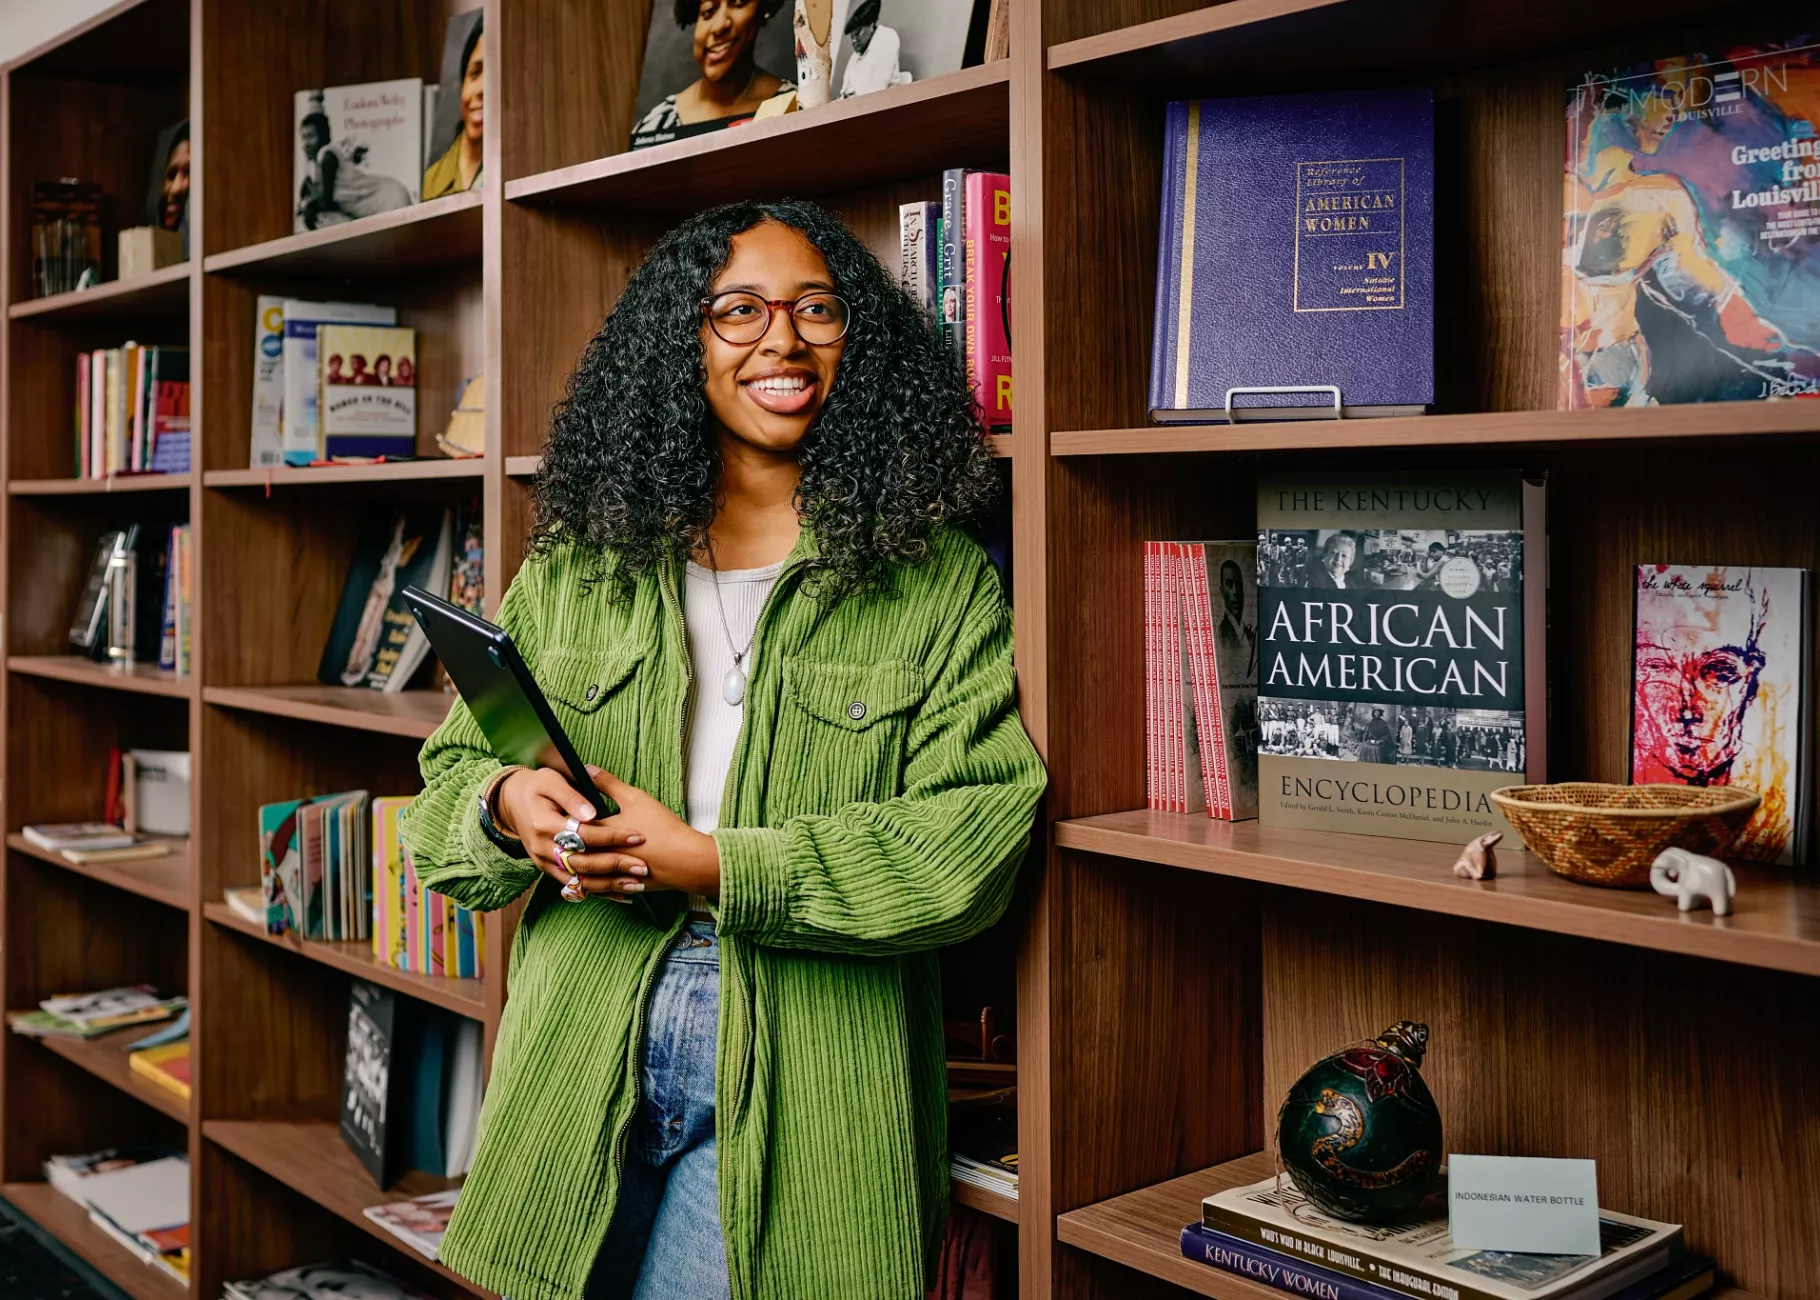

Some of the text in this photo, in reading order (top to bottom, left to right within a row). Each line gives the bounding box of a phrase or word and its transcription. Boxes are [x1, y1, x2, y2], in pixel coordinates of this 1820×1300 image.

[1672, 104, 1742, 123] LOUISVILLE
[1306, 166, 1362, 176] Reference
[1306, 176, 1365, 187] Library of
[944, 178, 956, 230] Grace
[1305, 194, 1394, 212] AMERICAN
[1304, 216, 1370, 232] WOMEN
[990, 233, 1002, 242] How
[944, 243, 956, 278] Grit
[1366, 252, 1396, 270] IV
[1340, 286, 1395, 294] International
[966, 286, 974, 320] YOUR
[966, 325, 974, 354] OWN
[1275, 489, 1493, 512] THE KENTUCKY
[1642, 574, 1659, 589] the
[1697, 578, 1742, 594] squirrel
[1265, 600, 1507, 650] AFRICAN
[1266, 651, 1509, 698] AMERICAN
[1280, 776, 1493, 814] ENCYCLOPEDIA
[1280, 801, 1299, 810] Edited
[1308, 804, 1328, 812] Gerald
[1336, 806, 1356, 815] Smith,
[1400, 812, 1431, 821] McDaniel,
[1470, 819, 1493, 827] Hardin
[1455, 1192, 1584, 1206] INDONESIAN WATER BOTTLE
[1205, 1244, 1339, 1300] KENTUCKY WOMEN
[1260, 1227, 1279, 1244] WHO'S
[1280, 1233, 1294, 1249] WHO
[1296, 1239, 1302, 1251] IN
[1303, 1241, 1324, 1258] BLACK
[1379, 1265, 1392, 1280] THE
[1393, 1269, 1432, 1294] INAUGURAL
[1432, 1282, 1459, 1300] EDITION
